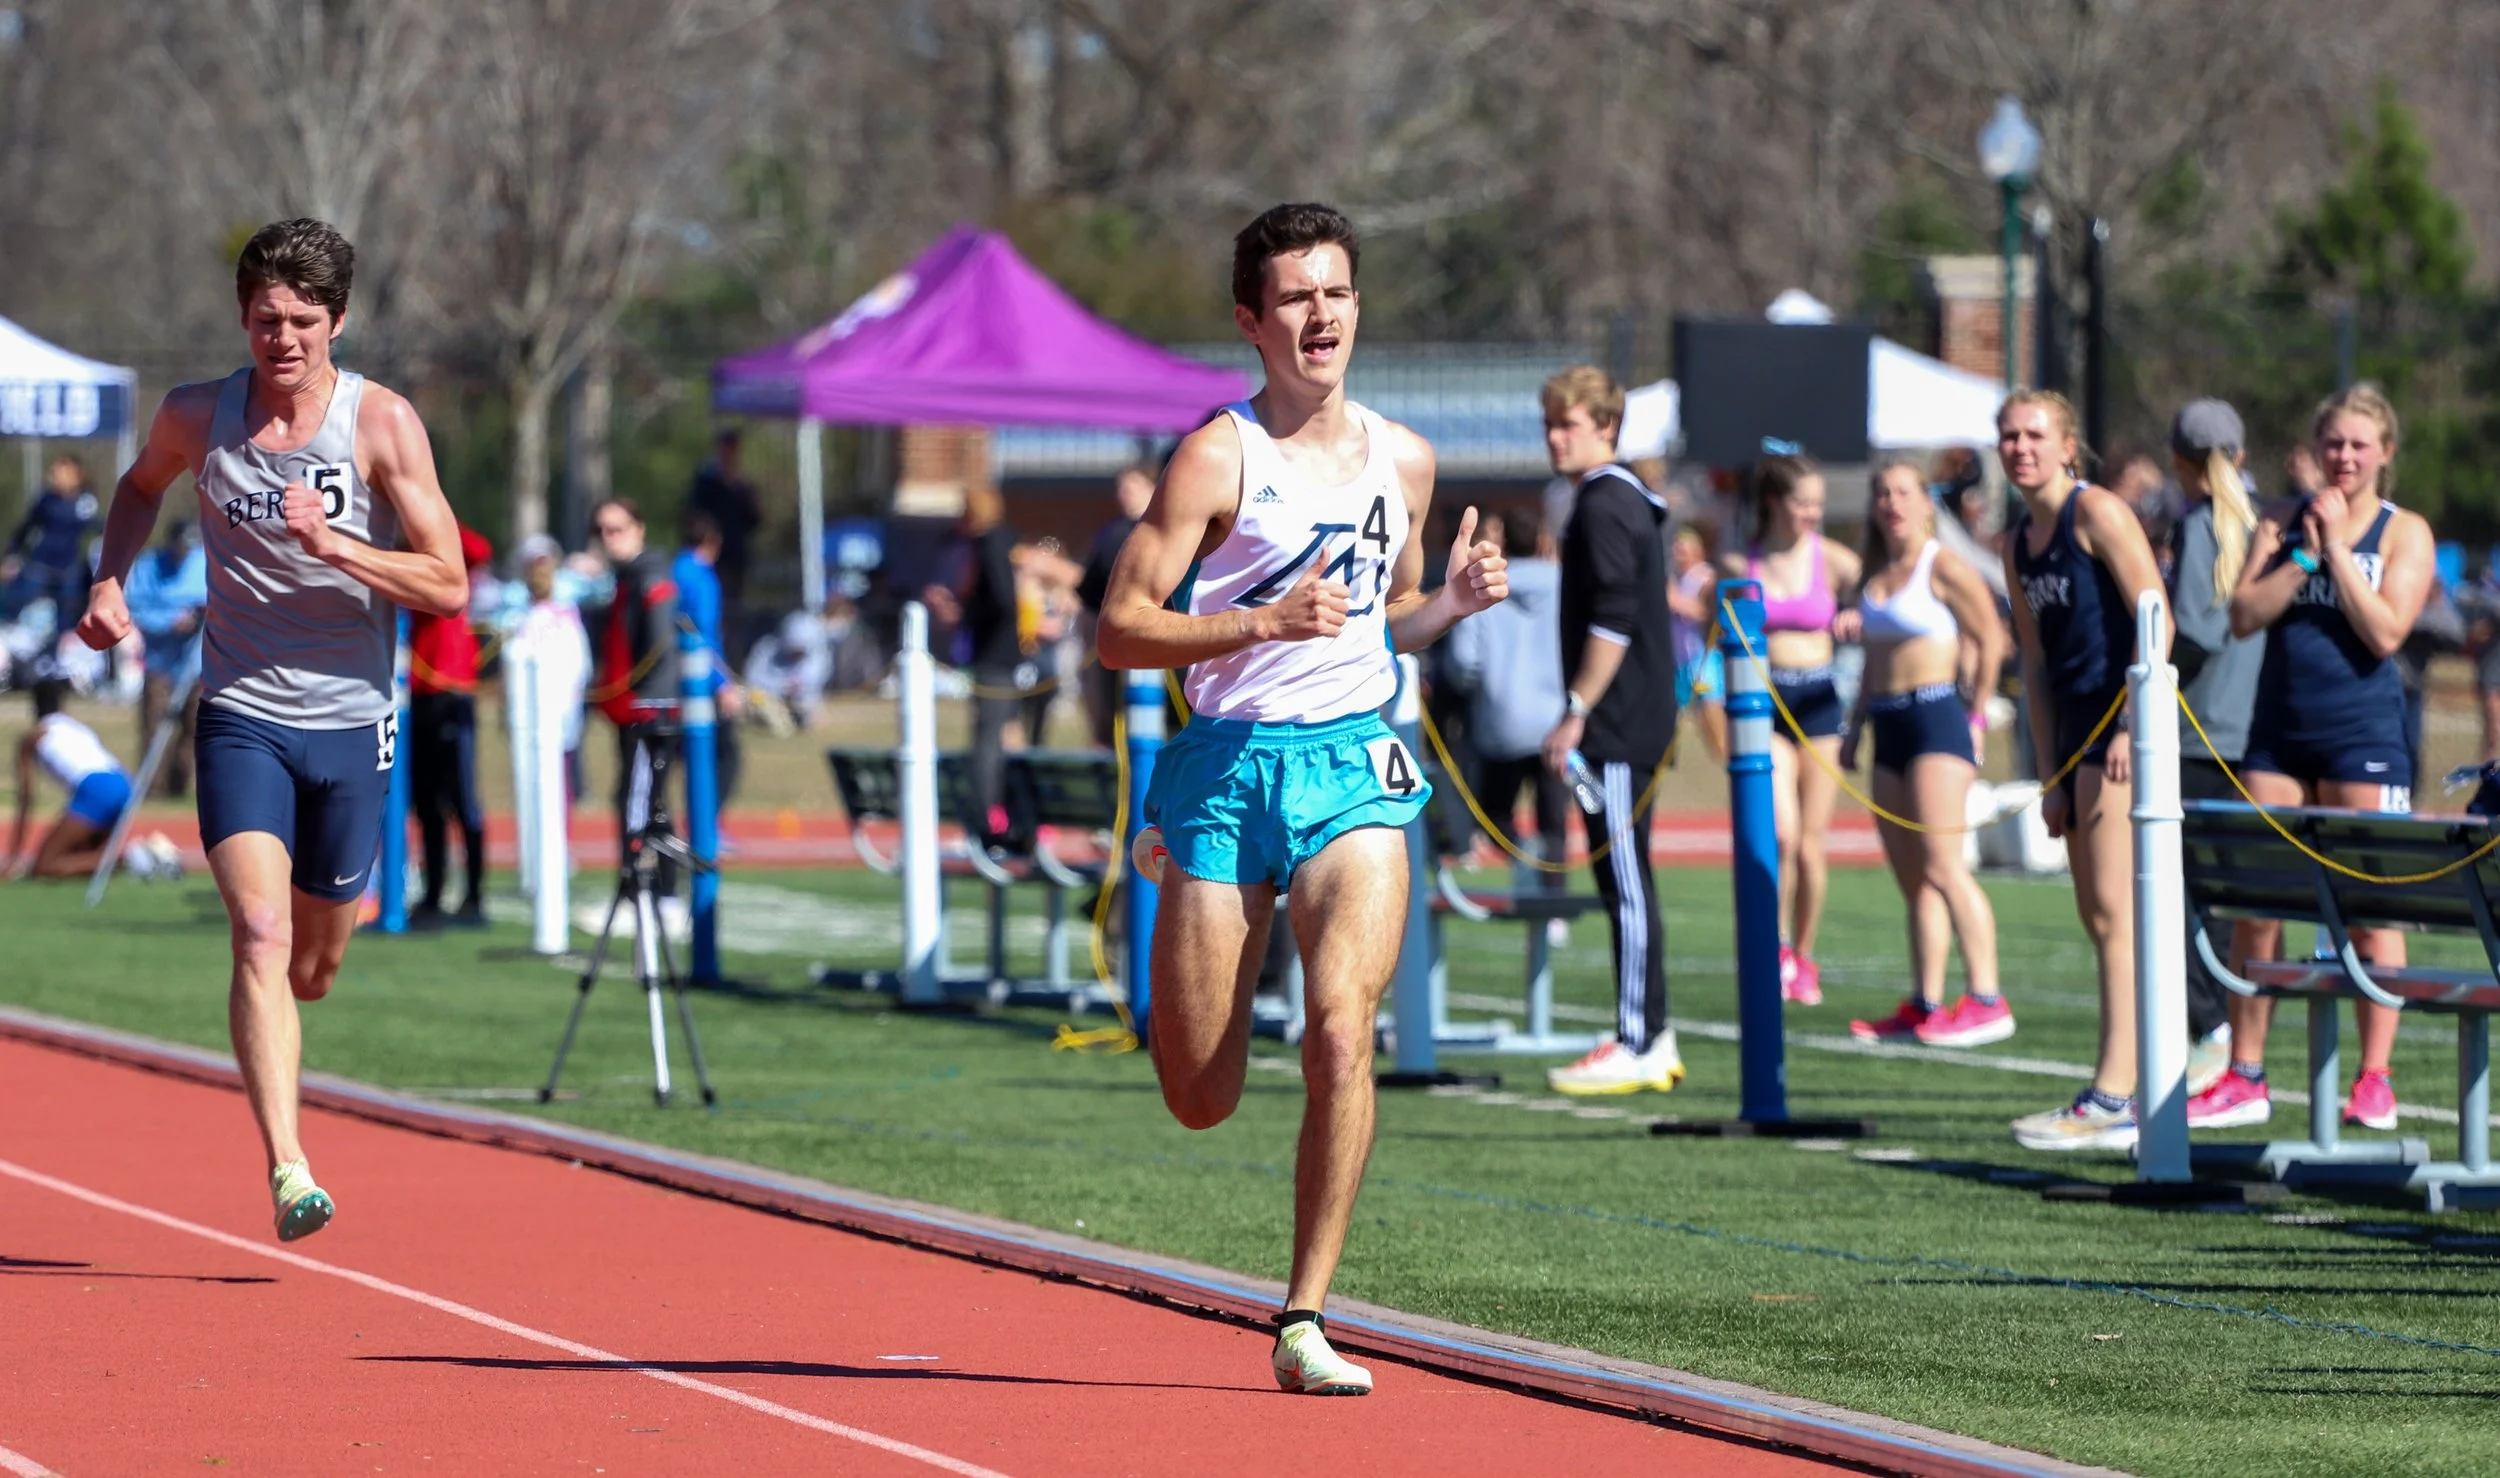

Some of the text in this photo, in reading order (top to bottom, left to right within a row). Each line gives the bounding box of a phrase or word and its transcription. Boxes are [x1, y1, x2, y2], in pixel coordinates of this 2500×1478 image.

[224, 490, 285, 530] BER
[314, 468, 346, 519] 5
[1361, 495, 1390, 555] 4
[1386, 743, 1416, 797] 4
